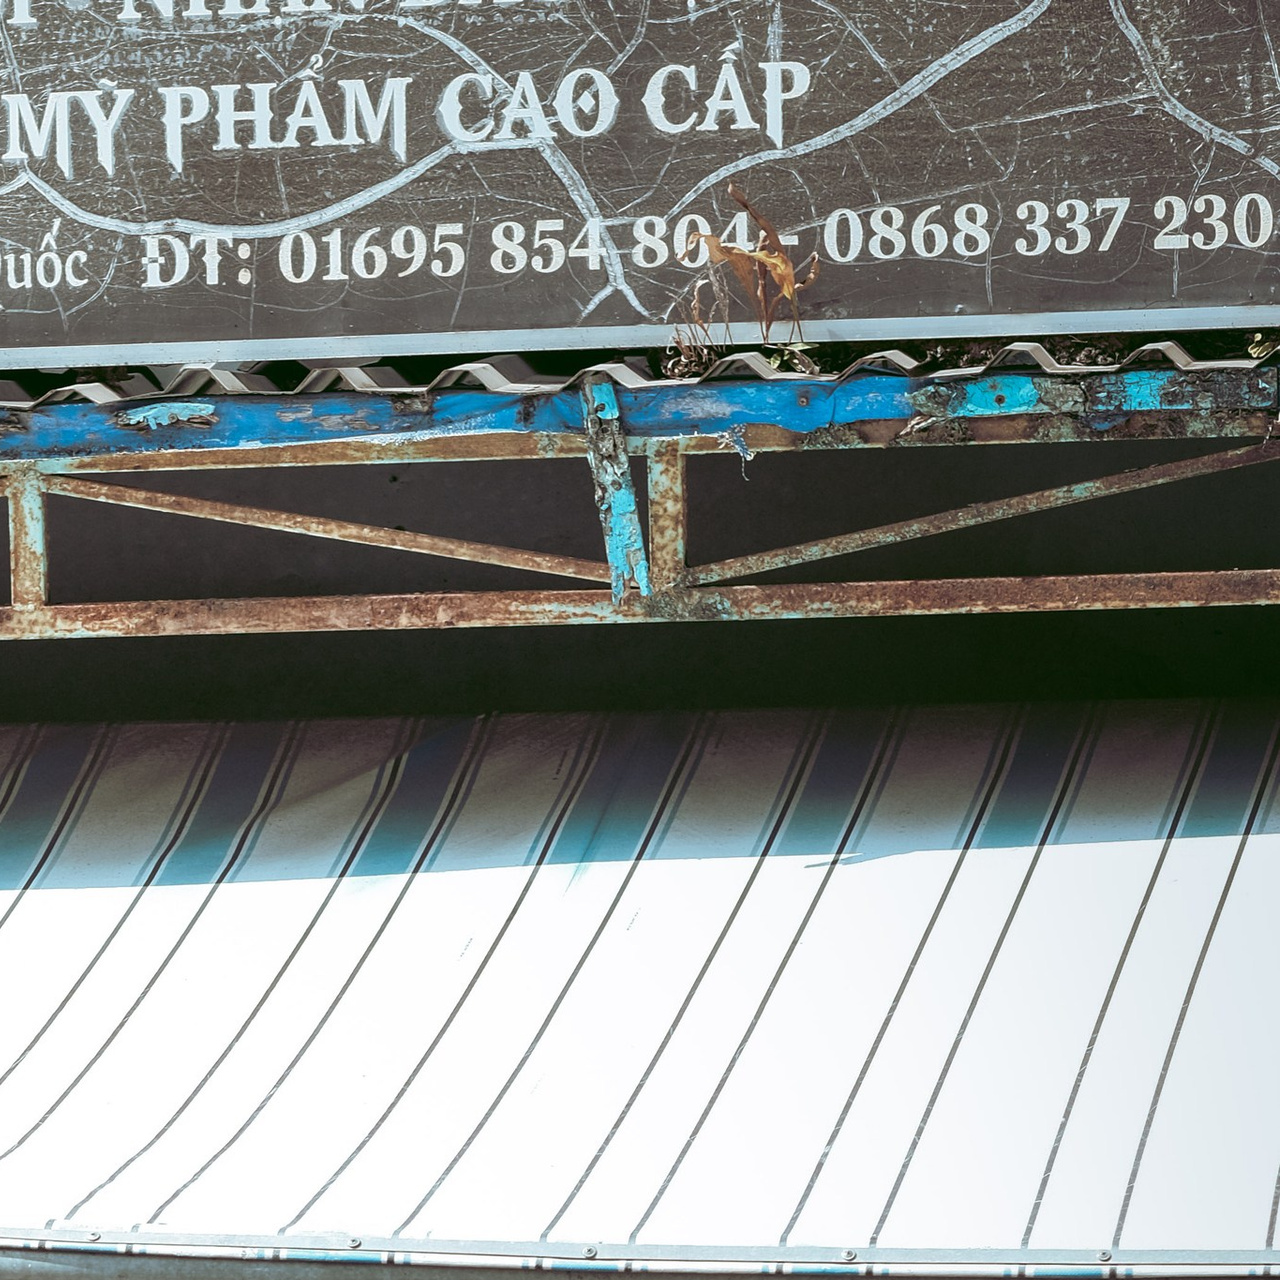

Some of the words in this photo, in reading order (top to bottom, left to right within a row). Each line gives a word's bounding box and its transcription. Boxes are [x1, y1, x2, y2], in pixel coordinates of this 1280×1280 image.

[2, 78, 134, 178] MỸ
[157, 53, 413, 174] PHẨM
[437, 67, 620, 142] CAO
[641, 40, 811, 150] CẤP
[141, 232, 252, 287] ĐT:
[278, 222, 465, 285] 01695
[490, 218, 606, 273] 854
[632, 210, 754, 268] 804
[824, 203, 990, 263] 0868
[1016, 197, 1131, 255] 337
[1154, 192, 1273, 250] 230
